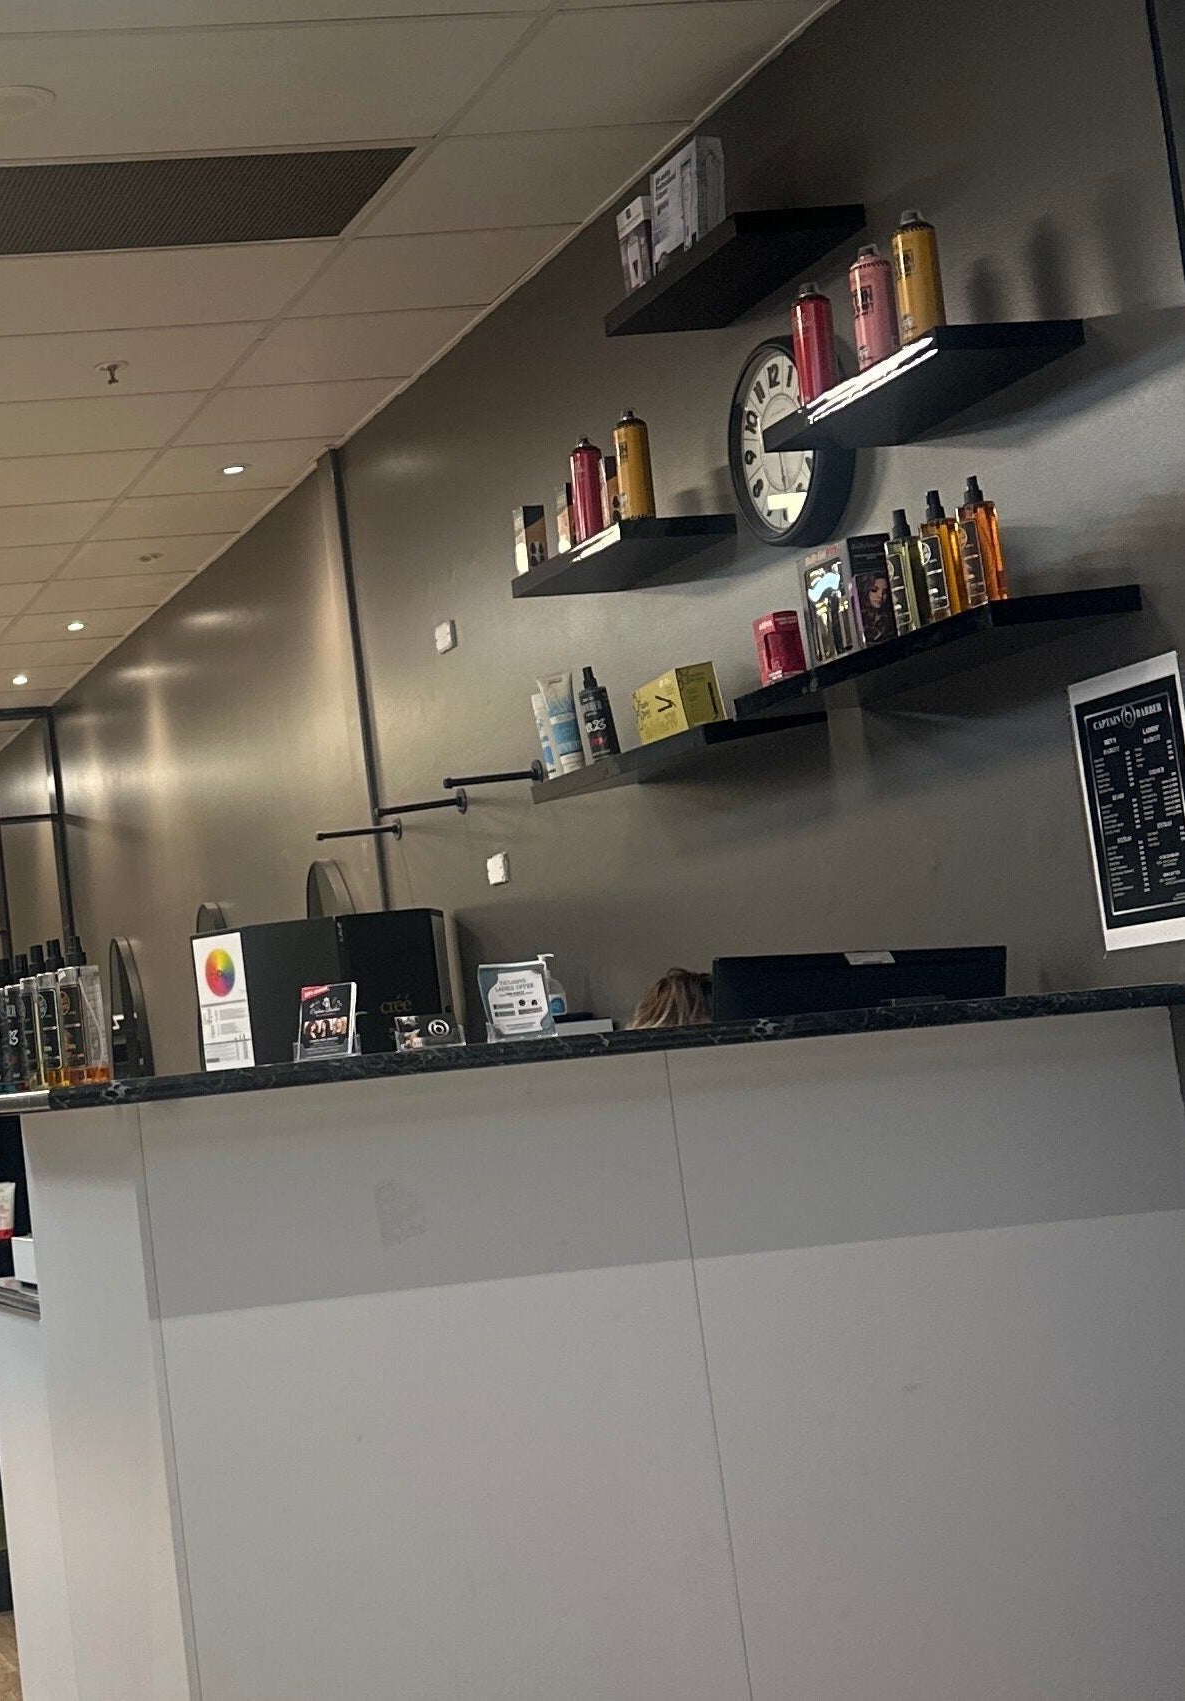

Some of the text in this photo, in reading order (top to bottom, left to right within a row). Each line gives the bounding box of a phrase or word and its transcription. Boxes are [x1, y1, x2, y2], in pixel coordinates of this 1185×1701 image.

[767, 363, 781, 389] 12
[753, 380, 766, 404] 11
[745, 410, 758, 435] 10
[745, 449, 757, 465] 9
[753, 478, 764, 498] 8
[1136, 702, 1162, 718] BARBER
